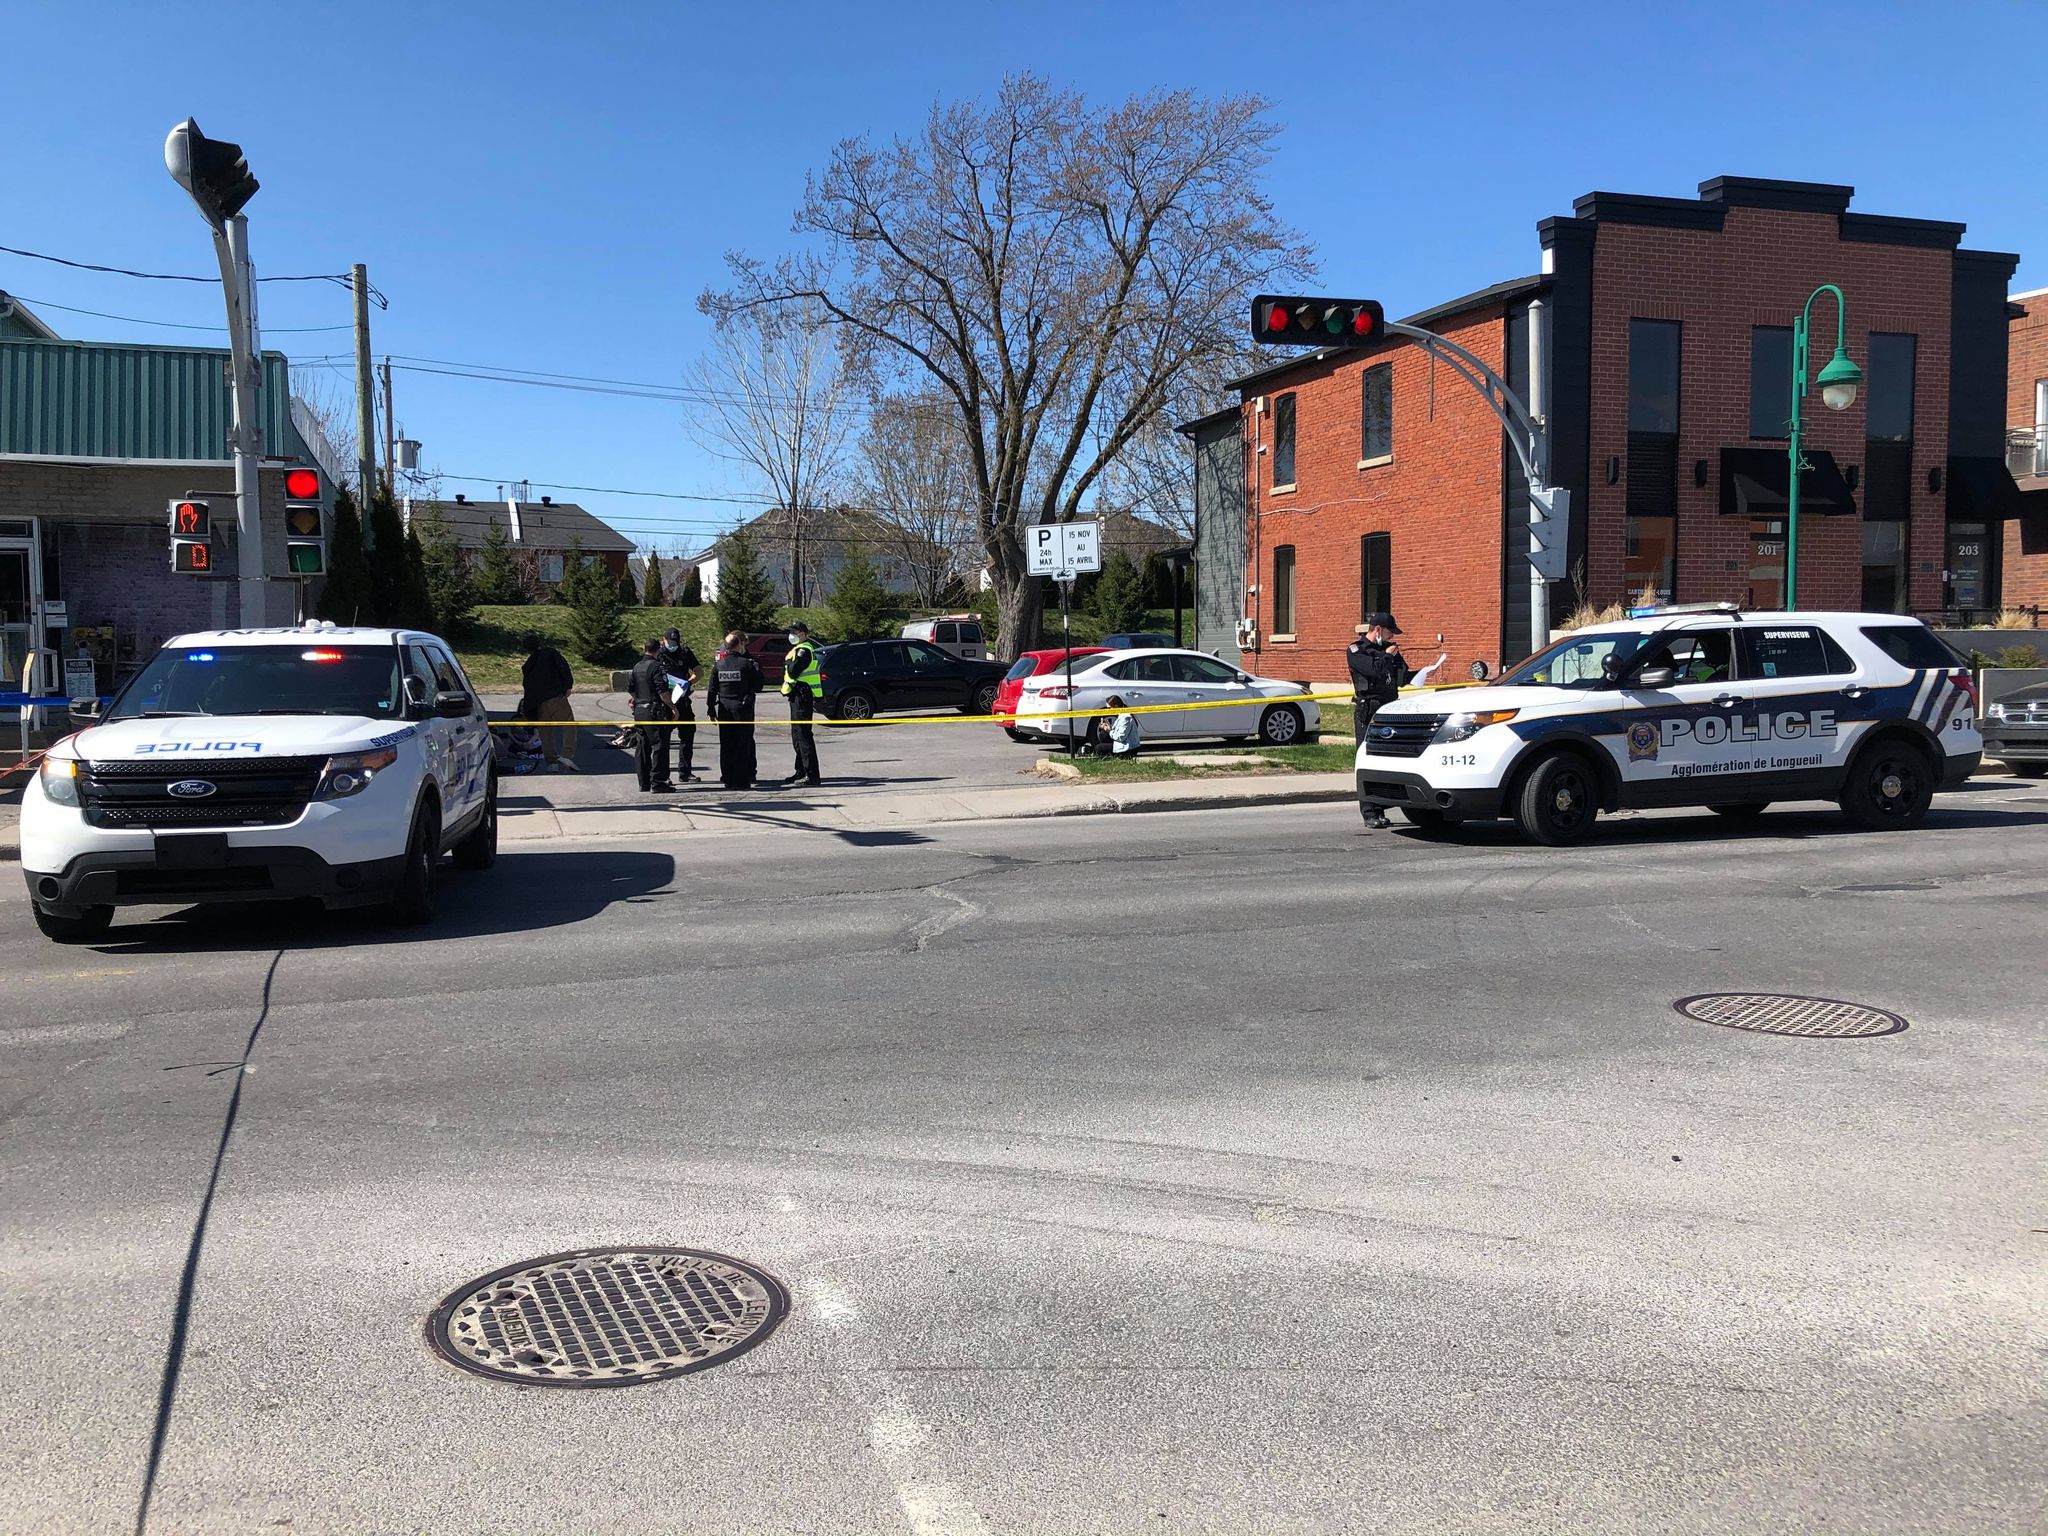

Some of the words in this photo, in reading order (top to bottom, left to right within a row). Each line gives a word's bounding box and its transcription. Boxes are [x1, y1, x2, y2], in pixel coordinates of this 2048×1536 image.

[1038, 530, 1051, 547] P
[1757, 544, 1777, 555] 201
[1958, 545, 1979, 556] 203
[1040, 558, 1052, 566] MAX
[1077, 556, 1094, 564] AVRIL
[1764, 631, 1810, 639] SUPERVISEUR
[720, 672, 740, 680] POLICE
[1660, 709, 1838, 747] POLICE
[1952, 717, 1971, 731] 91
[1441, 754, 1476, 766] 31-12
[1671, 760, 1750, 777] Agglomération
[1754, 758, 1766, 769] de
[1770, 754, 1823, 770] Longueuil
[177, 782, 205, 794] Ford
[661, 1256, 722, 1274] VILLE
[723, 1272, 752, 1287] DE
